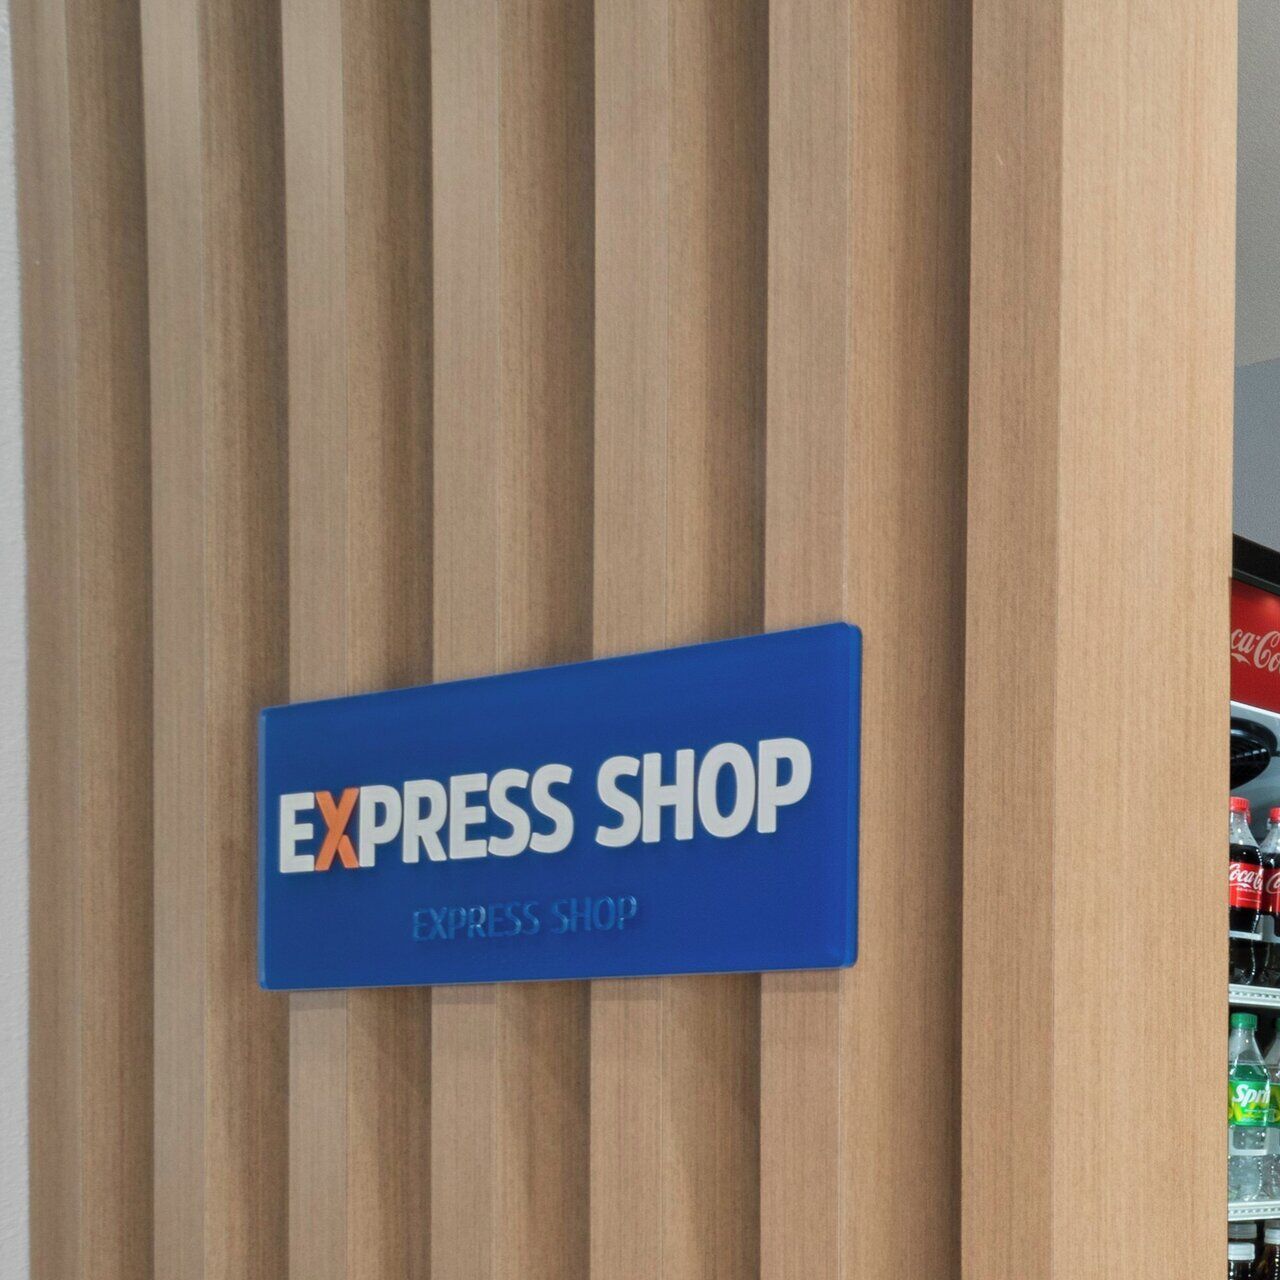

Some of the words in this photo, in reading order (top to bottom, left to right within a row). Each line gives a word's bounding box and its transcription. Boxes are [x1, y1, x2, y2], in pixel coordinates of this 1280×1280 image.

[279, 763, 575, 873] EXPRESS
[595, 737, 812, 848] SHOP
[411, 901, 541, 942] EXPRESS
[550, 894, 638, 934] SHOP
[1232, 1084, 1270, 1107] Spri
